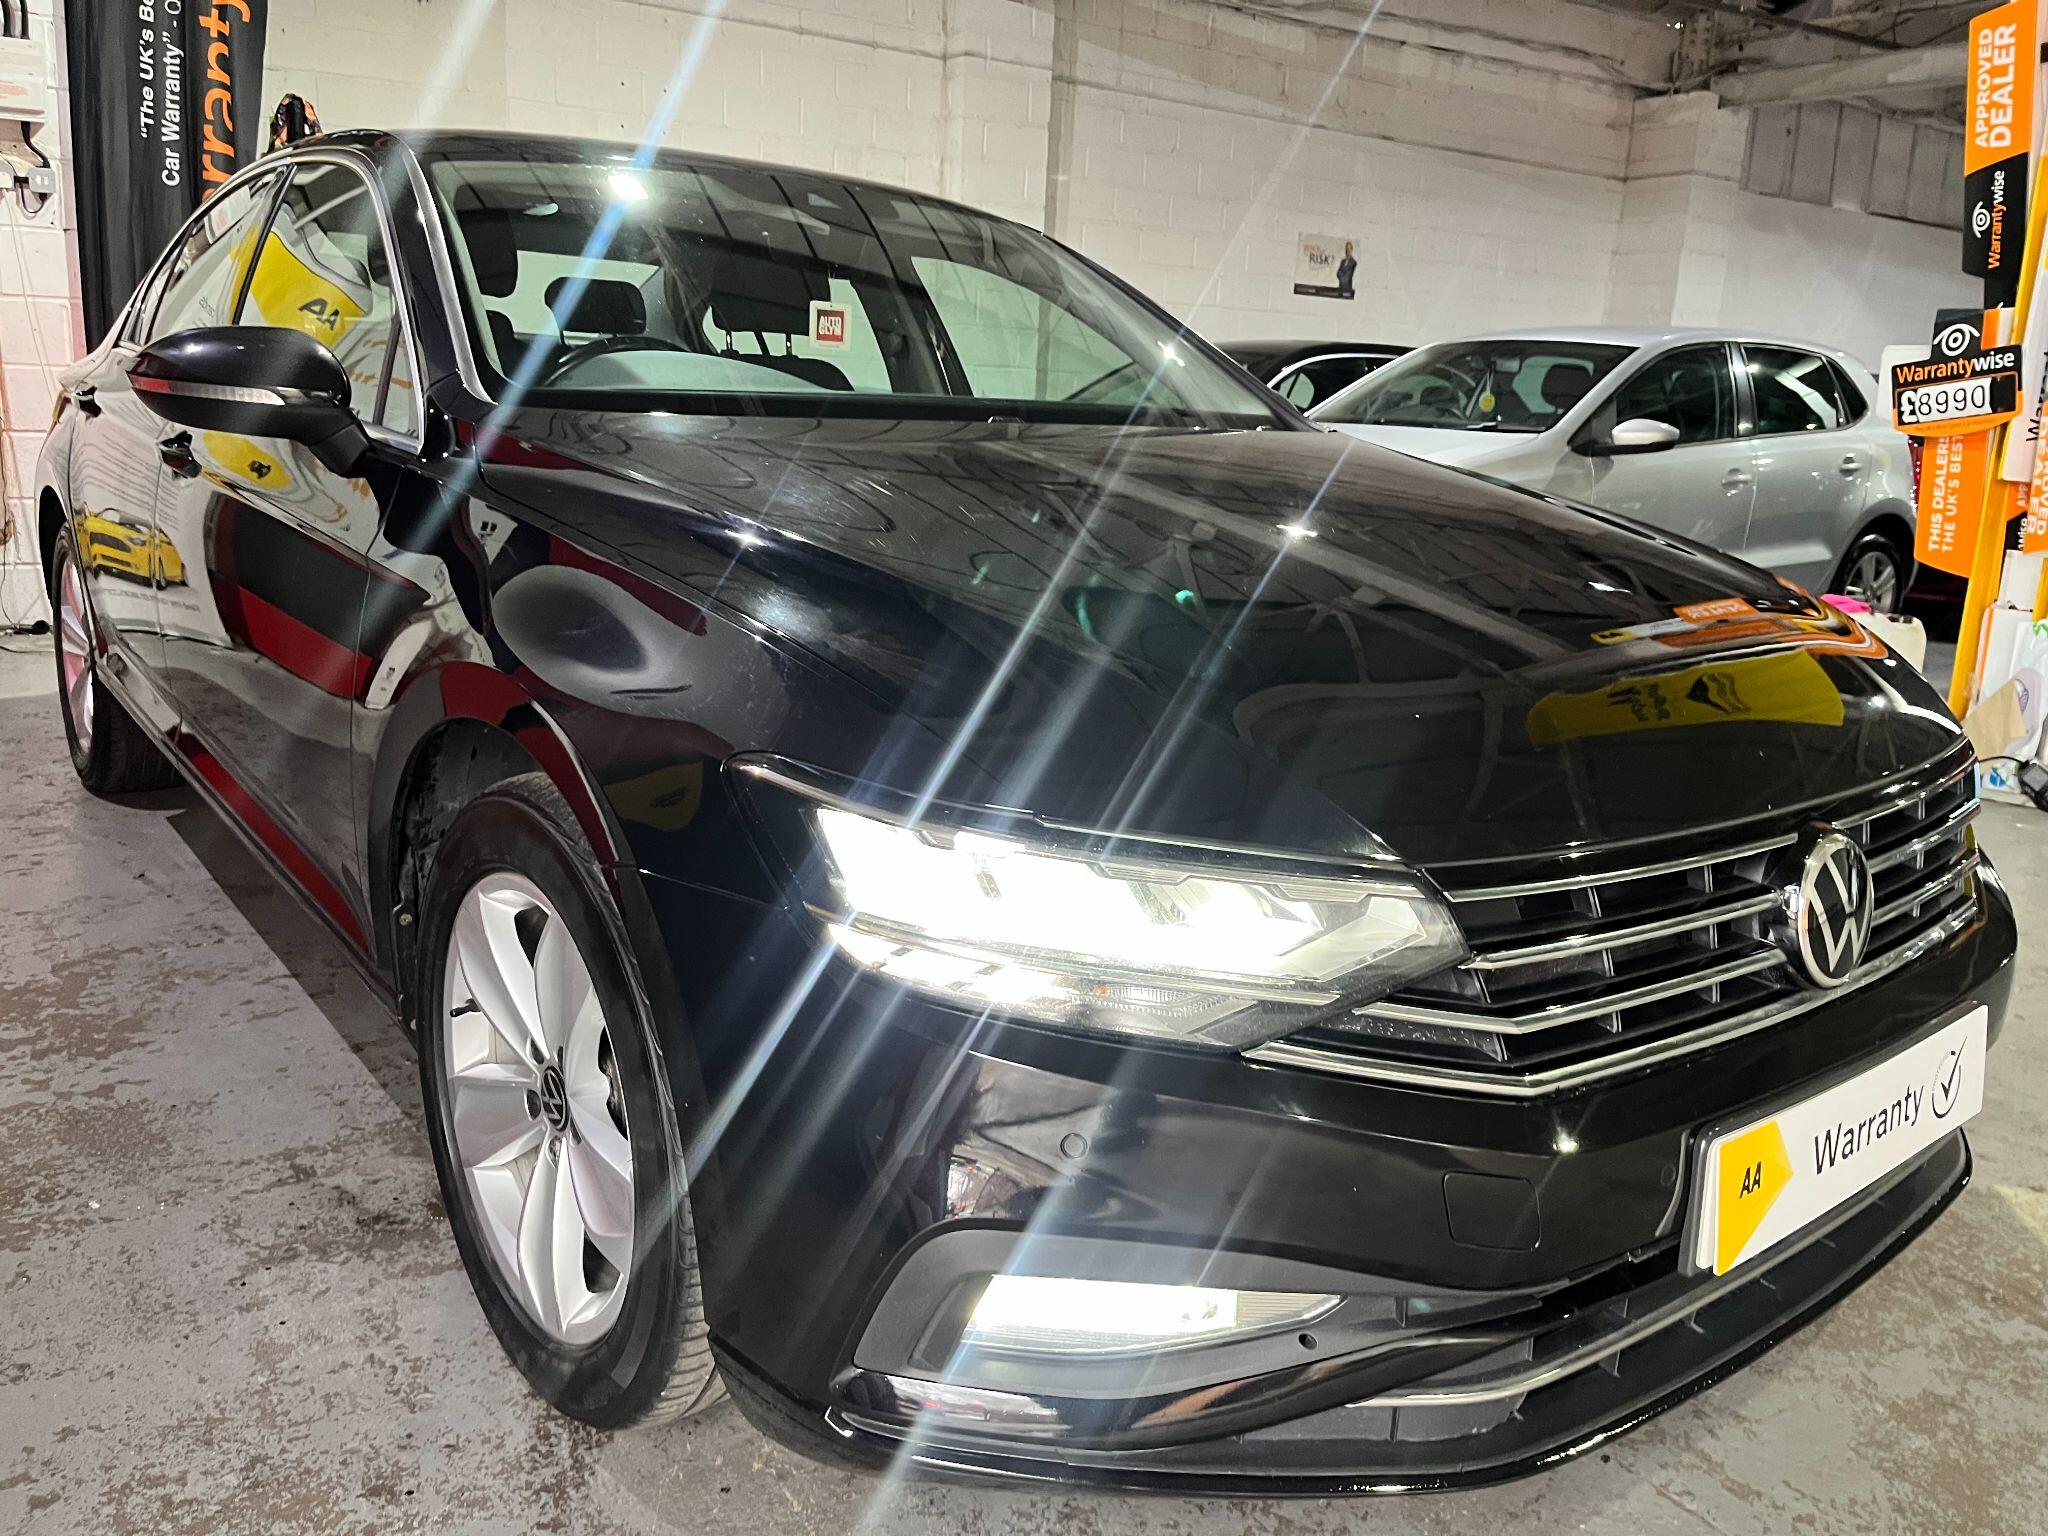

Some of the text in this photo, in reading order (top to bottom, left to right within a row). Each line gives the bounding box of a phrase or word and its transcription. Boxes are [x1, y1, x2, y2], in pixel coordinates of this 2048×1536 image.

[161, 31, 185, 142] Warranty”
[198, 0, 251, 204] rranty
[1974, 28, 1993, 148] APPROVED
[1989, 23, 2017, 148] DEALER
[161, 148, 180, 187] Car
[1987, 170, 2007, 270] Warrantywise
[1896, 351, 2015, 384] Warrantywise
[1900, 385, 1986, 424] £8990
[1944, 479, 1960, 517] UK'S
[1928, 513, 1943, 553] THIS
[1941, 522, 1956, 553] THE
[1814, 1083, 1925, 1176] Warranty
[1739, 1161, 1763, 1200] AA
